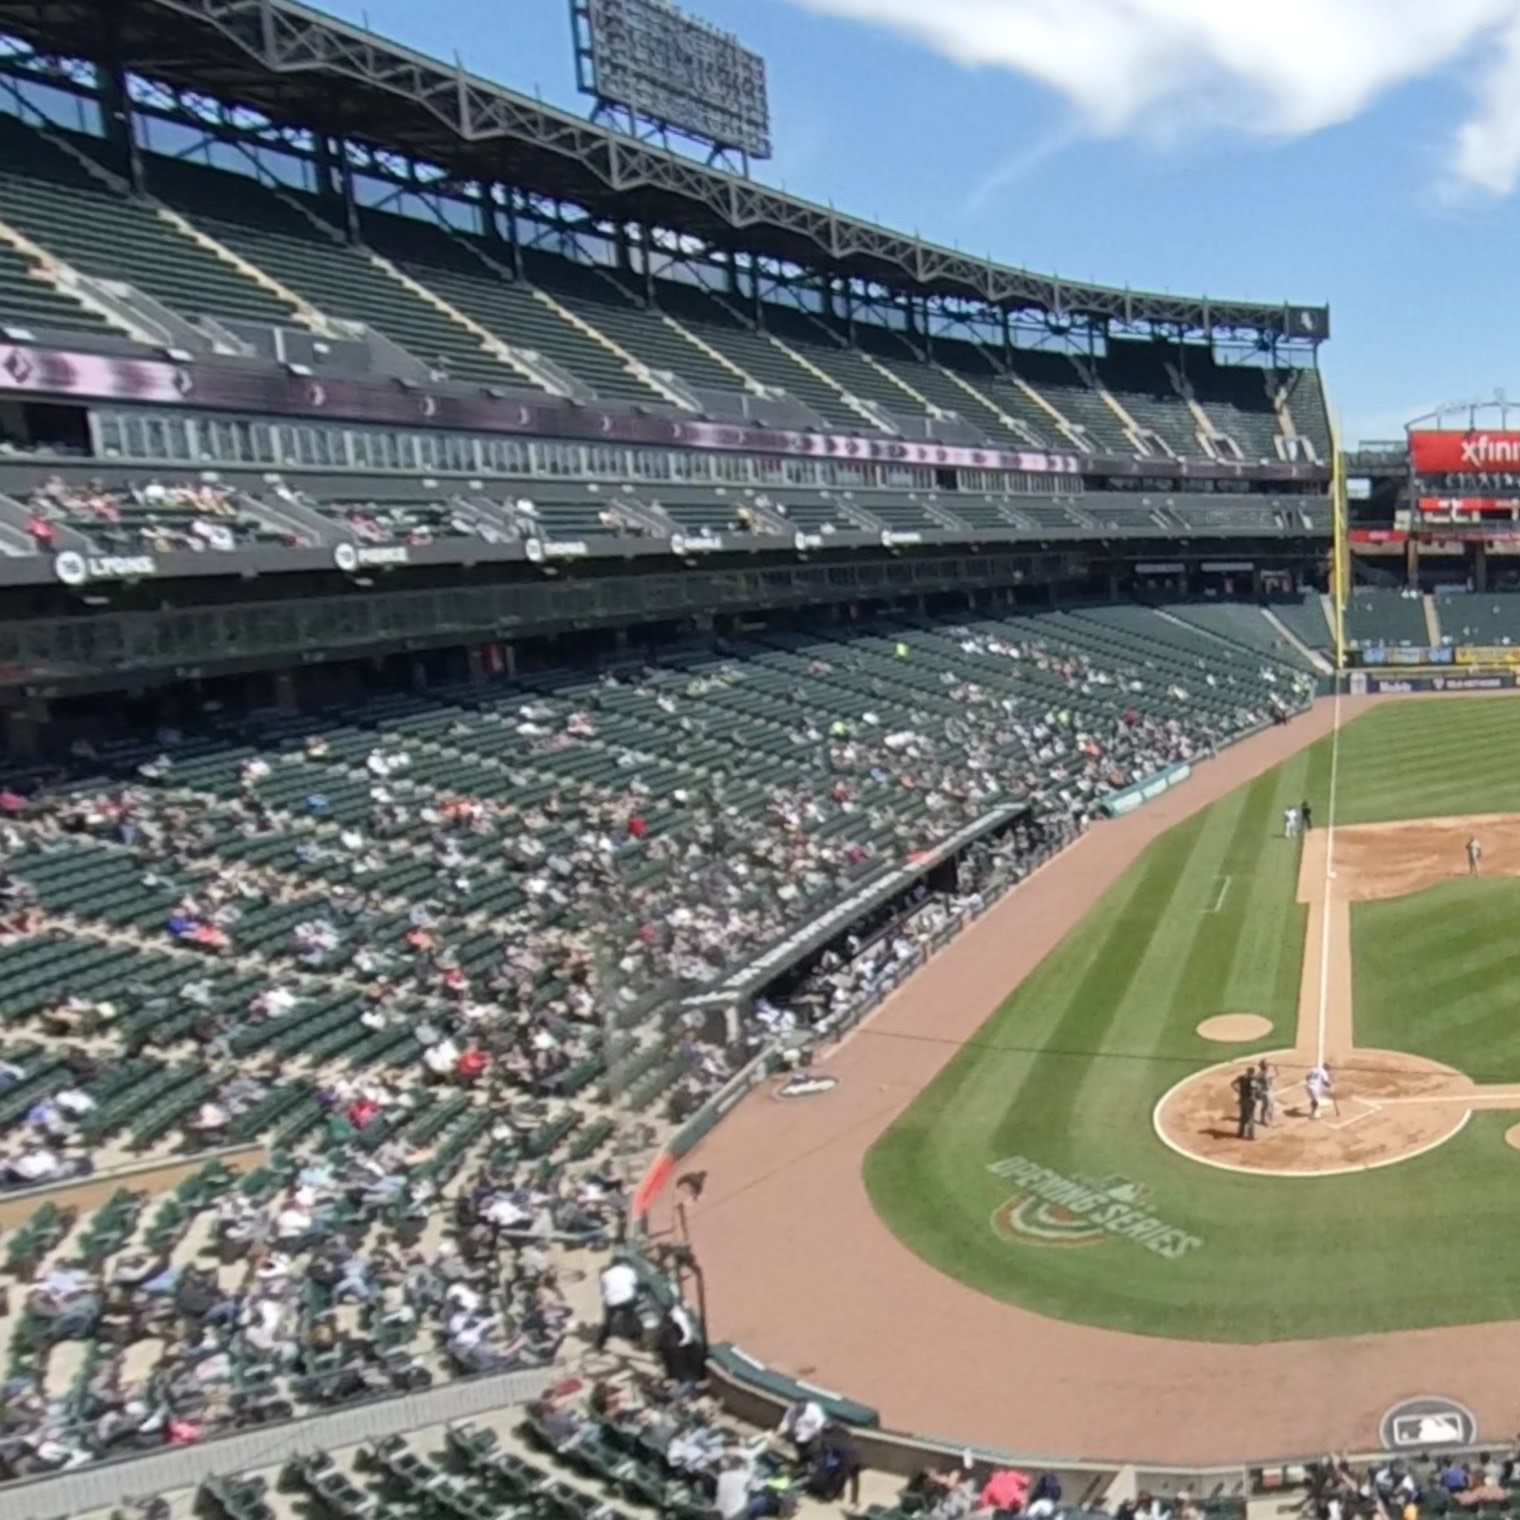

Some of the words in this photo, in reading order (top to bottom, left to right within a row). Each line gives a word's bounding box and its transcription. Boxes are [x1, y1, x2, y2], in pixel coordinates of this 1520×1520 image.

[89, 556, 156, 576] LYONS
[986, 1156, 1110, 1213] OPENING
[1088, 1203, 1204, 1258] SERIES
